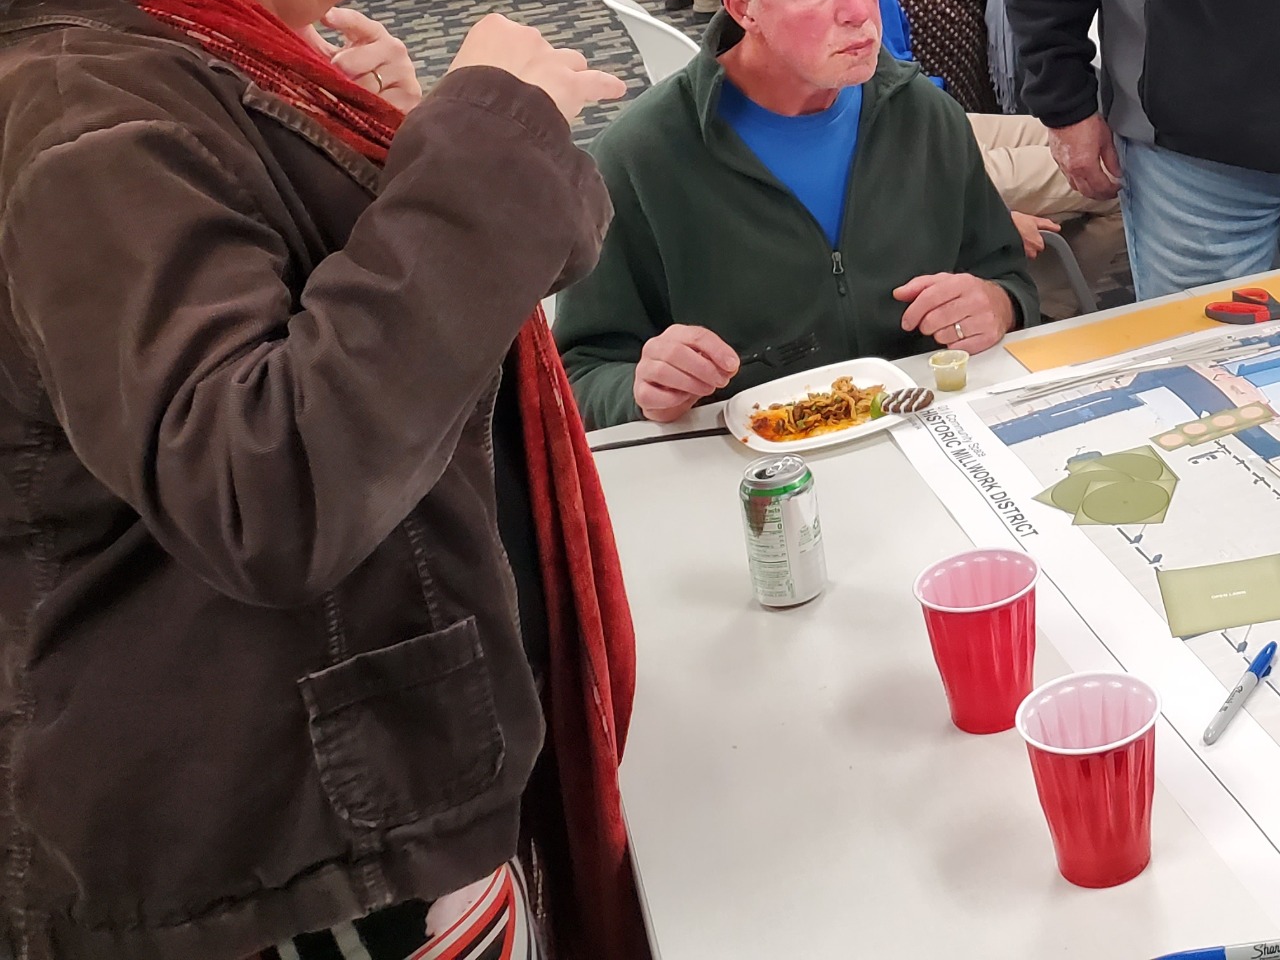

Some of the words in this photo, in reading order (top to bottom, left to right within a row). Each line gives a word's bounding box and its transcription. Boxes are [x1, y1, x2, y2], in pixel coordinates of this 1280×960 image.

[920, 408, 962, 448] HISTORIC
[950, 448, 1002, 493] MILLWORK
[989, 491, 1039, 537] DISTRICT
